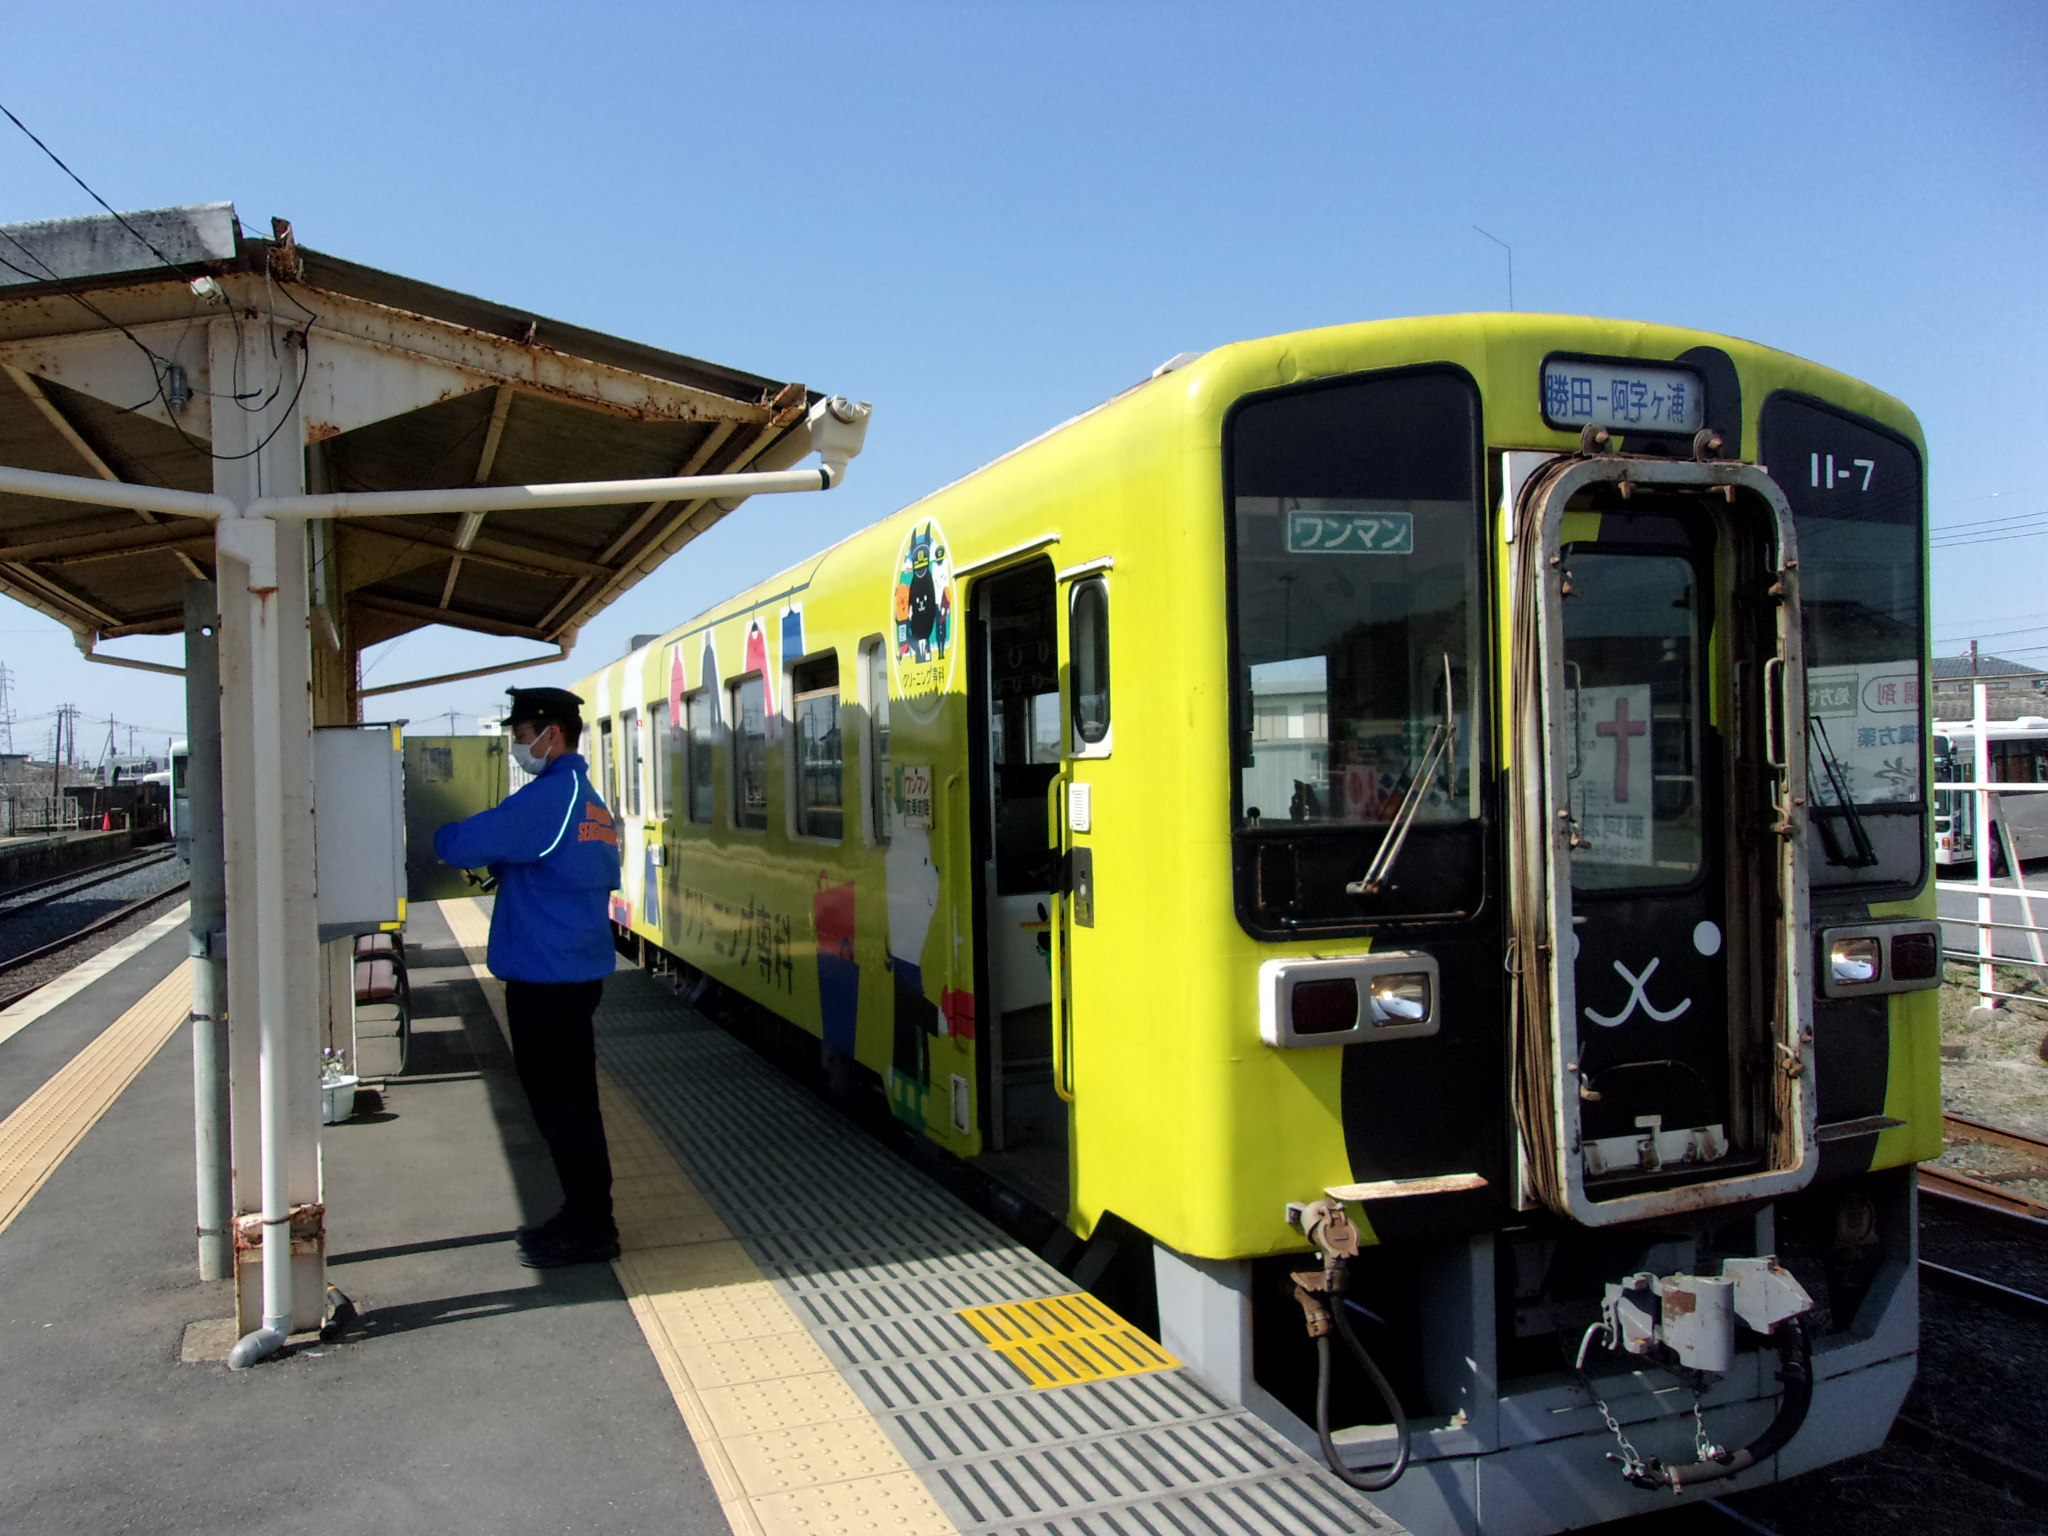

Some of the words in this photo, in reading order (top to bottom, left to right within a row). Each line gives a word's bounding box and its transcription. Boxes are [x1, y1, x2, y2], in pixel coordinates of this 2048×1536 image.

[1810, 452, 1875, 491] 11-7
[1295, 518, 1407, 548] ワンマン
[685, 887, 793, 996] クリーニング専科
